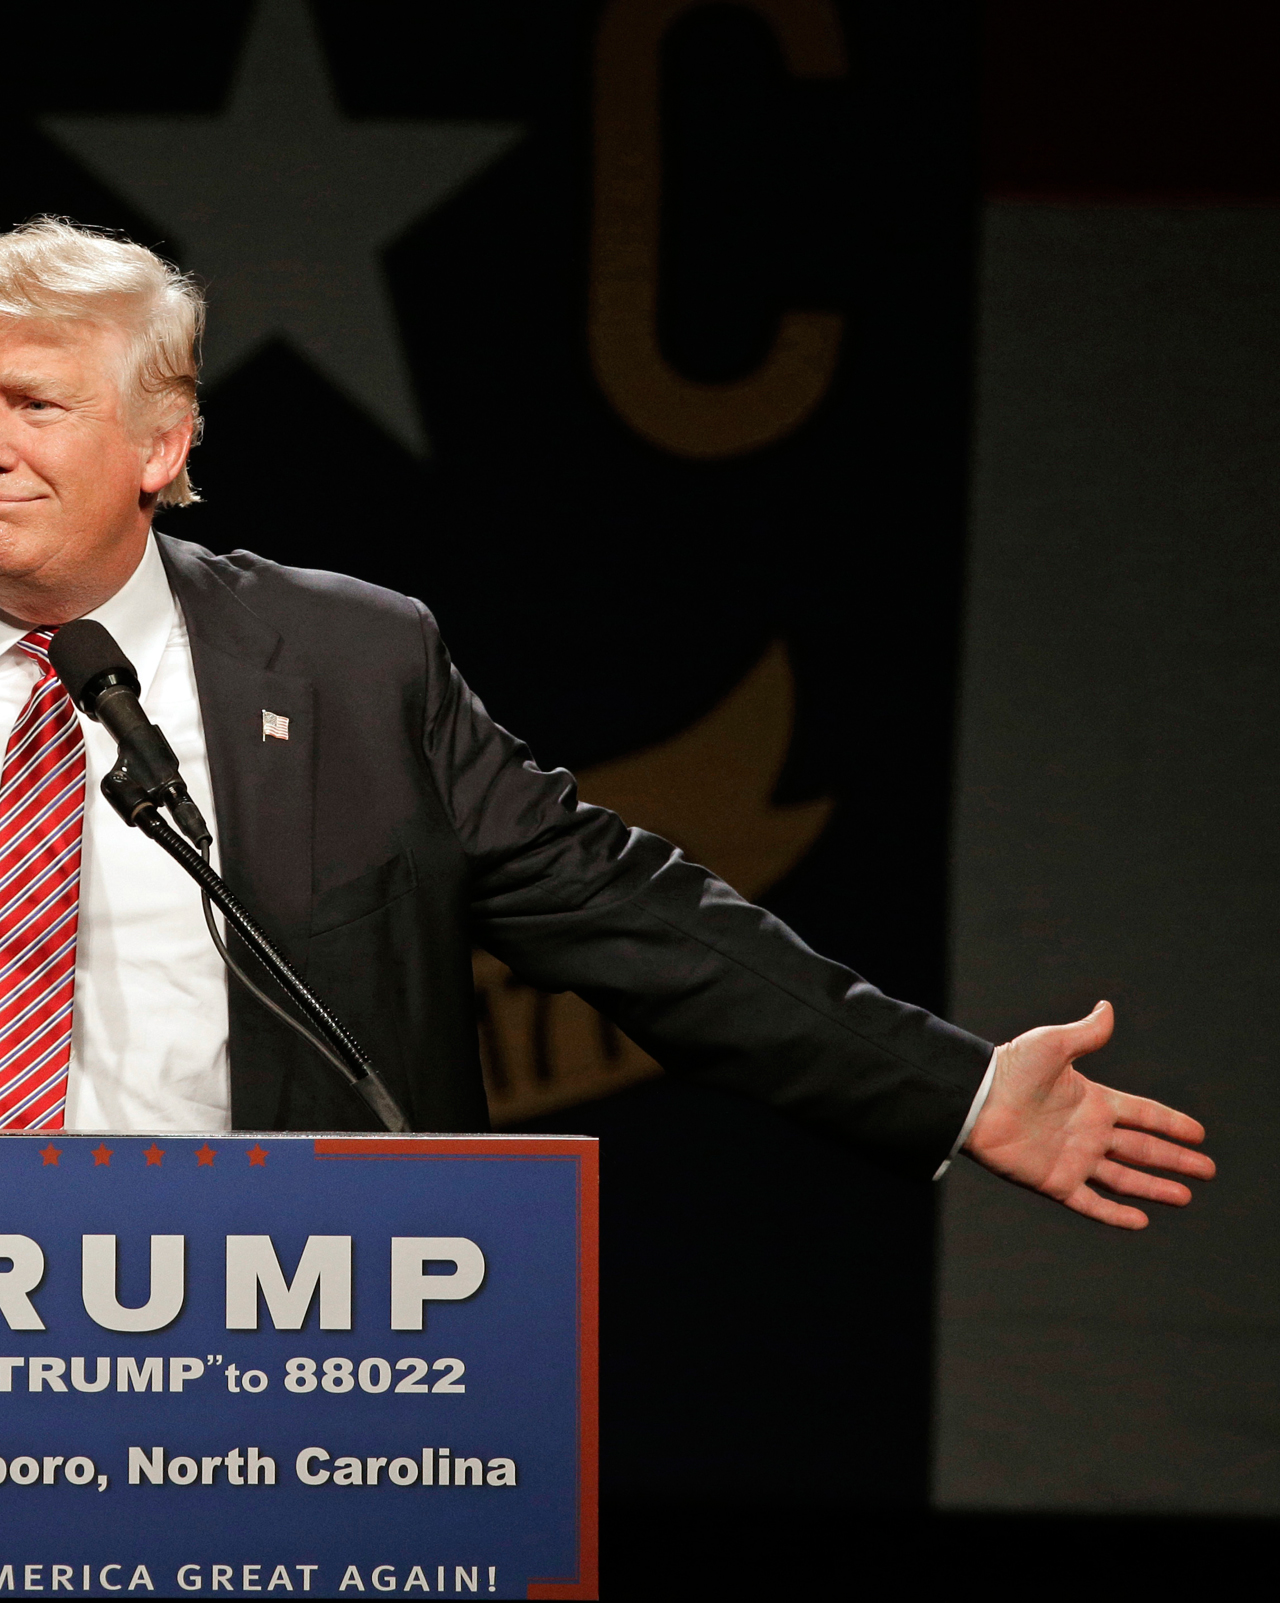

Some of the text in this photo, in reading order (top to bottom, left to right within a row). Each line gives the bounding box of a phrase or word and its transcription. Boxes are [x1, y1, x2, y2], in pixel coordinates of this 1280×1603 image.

[587, 0, 848, 458] C
[284, 1356, 466, 1394] 88022
[128, 1446, 276, 1485] North
[295, 1446, 517, 1487] Carolina
[176, 1564, 319, 1592] GREAT
[338, 1564, 496, 1593] AGAIN!
